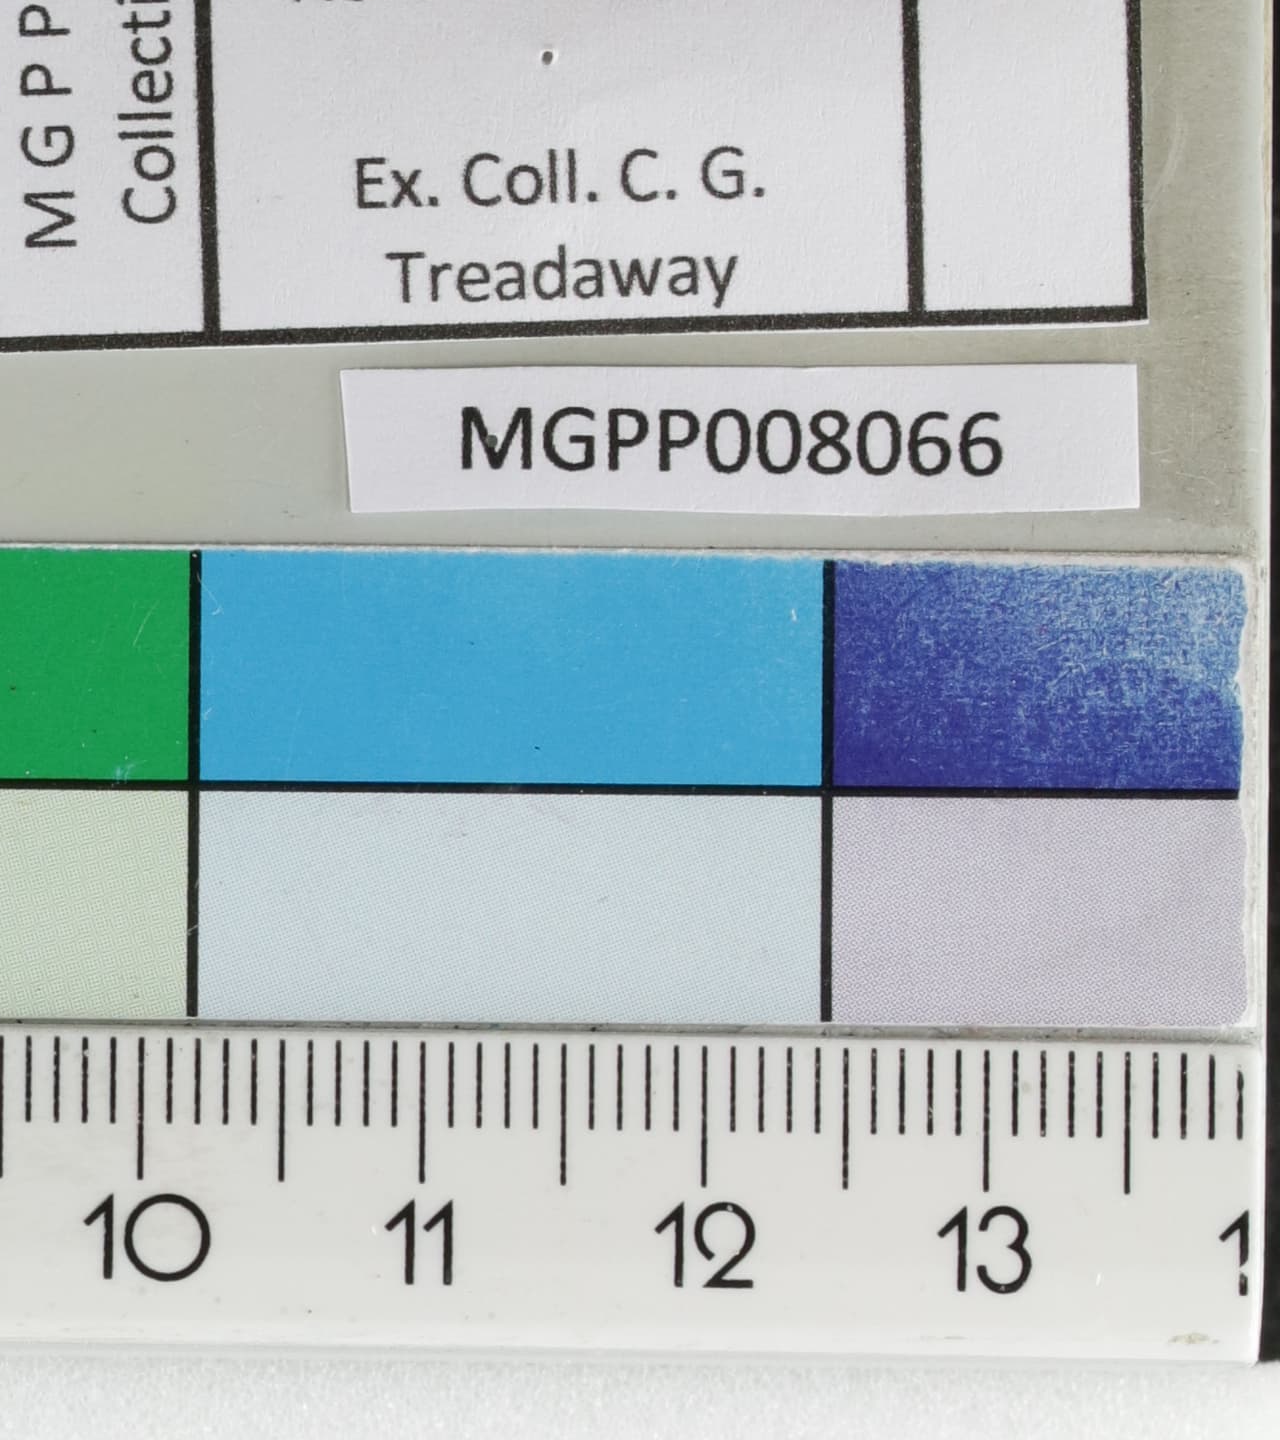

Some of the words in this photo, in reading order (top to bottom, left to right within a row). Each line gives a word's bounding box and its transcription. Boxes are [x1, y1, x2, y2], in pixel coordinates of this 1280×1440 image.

[18, 63, 73, 97] P
[19, 124, 76, 168] G
[354, 156, 440, 210] Ex.
[461, 147, 599, 208] Coll.
[619, 147, 678, 203] C.
[700, 144, 766, 201] G.
[22, 189, 78, 249] M
[384, 245, 739, 310] Treadaway
[460, 405, 1004, 478] MGPP008066
[82, 1192, 212, 1283] 10
[383, 1197, 454, 1287] 11
[653, 1200, 757, 1290] 12
[936, 1204, 1033, 1295] 13
